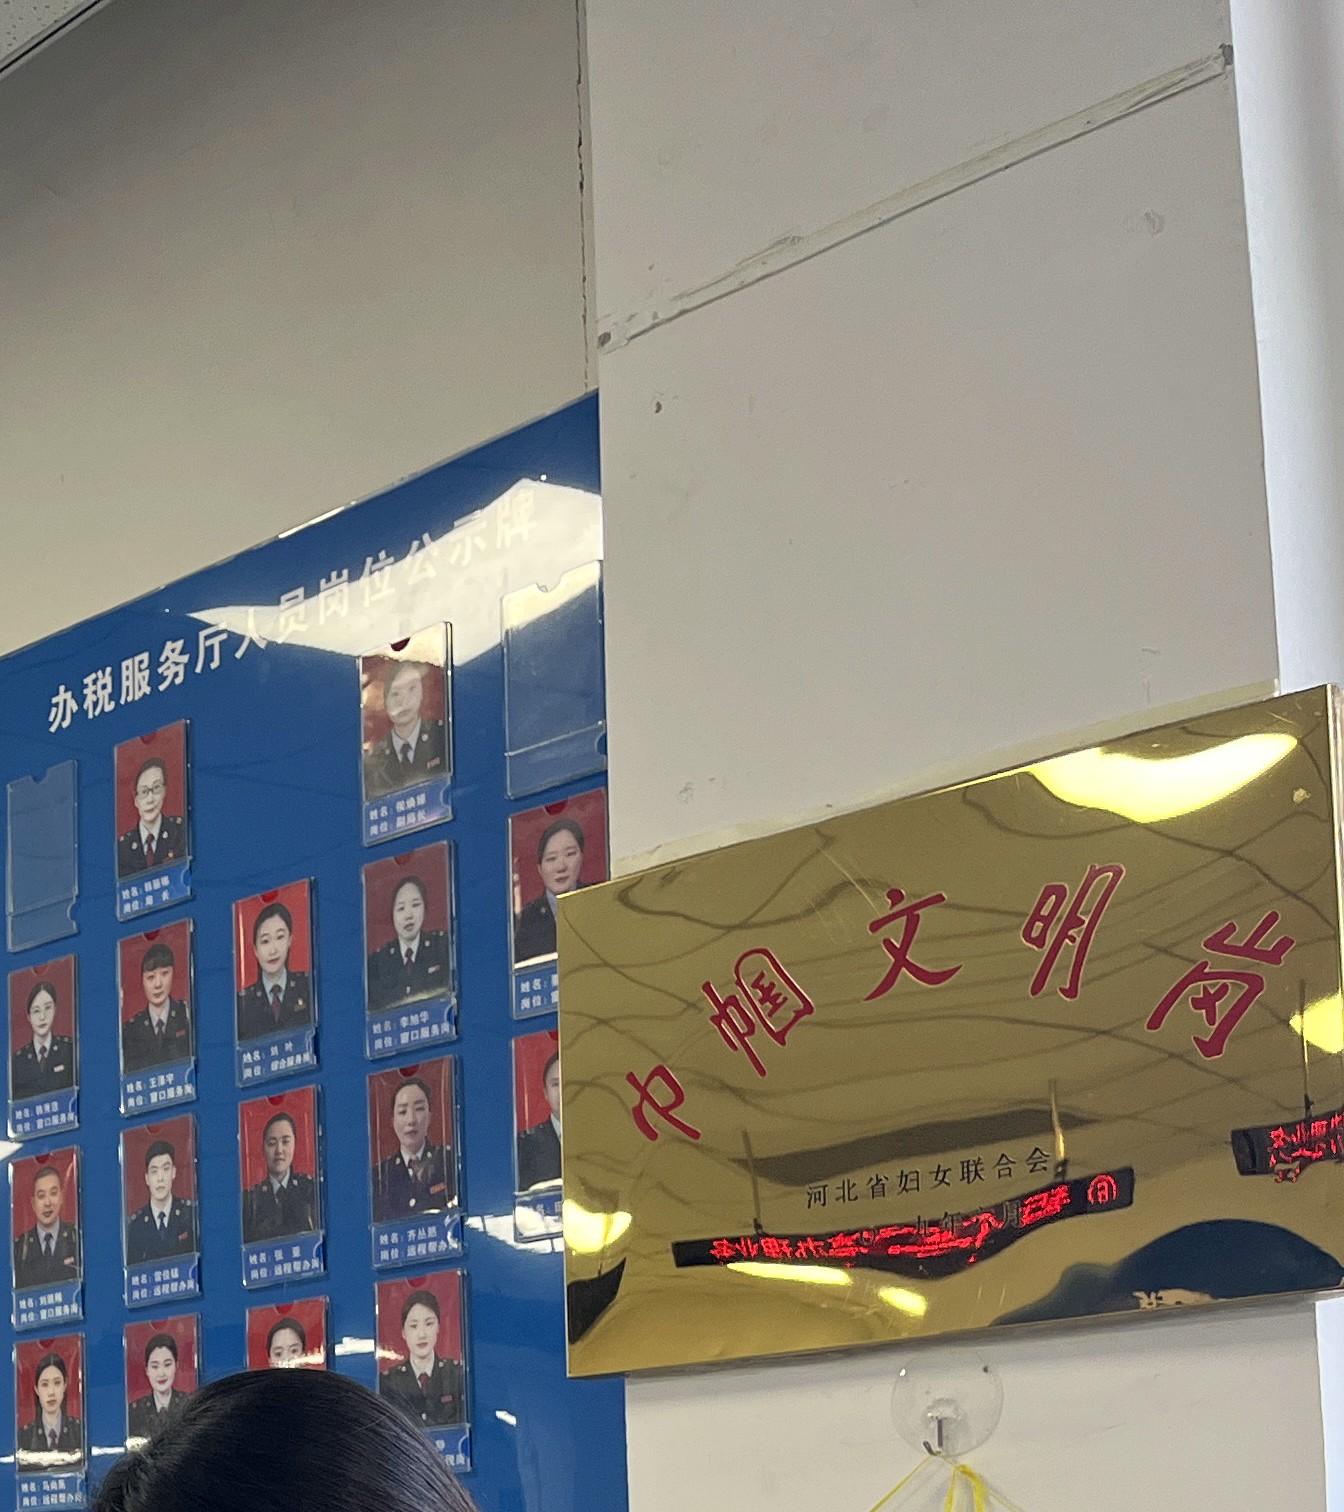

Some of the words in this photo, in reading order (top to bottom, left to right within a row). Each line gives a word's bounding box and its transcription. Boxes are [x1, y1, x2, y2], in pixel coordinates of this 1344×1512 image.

[46, 492, 538, 733] 办税服务厅人员岗位公示牌
[625, 863, 1296, 1144] 巾帼文明岗
[805, 1146, 1053, 1210] 河北省妇女联合会
